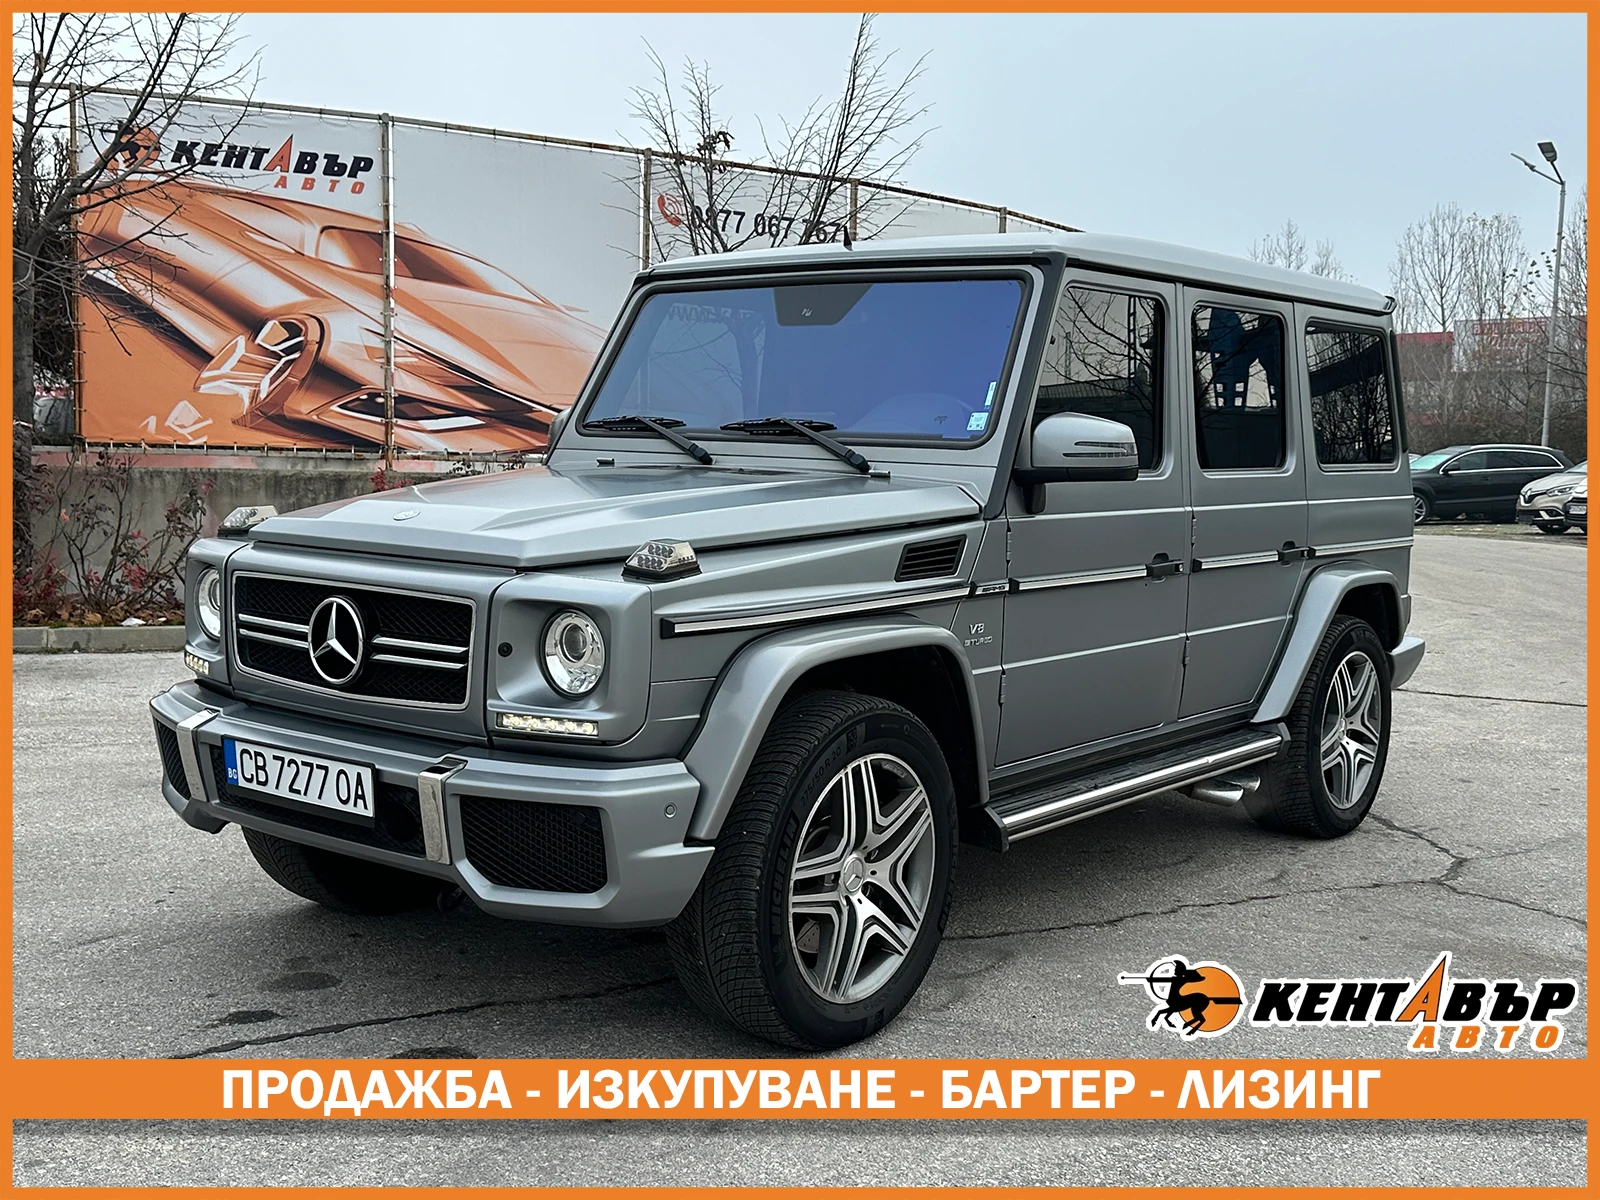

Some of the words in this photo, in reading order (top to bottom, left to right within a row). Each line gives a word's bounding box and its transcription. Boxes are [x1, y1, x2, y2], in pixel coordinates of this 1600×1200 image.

[171, 134, 374, 179] КЕНТАВЪР
[274, 175, 366, 195] АВТО
[754, 213, 795, 239] 067
[969, 623, 985, 635] V8
[228, 767, 238, 780] BG
[240, 748, 269, 787] CB
[272, 754, 329, 800] 7277
[335, 768, 369, 811] OA
[771, 814, 799, 936] MICHELIN
